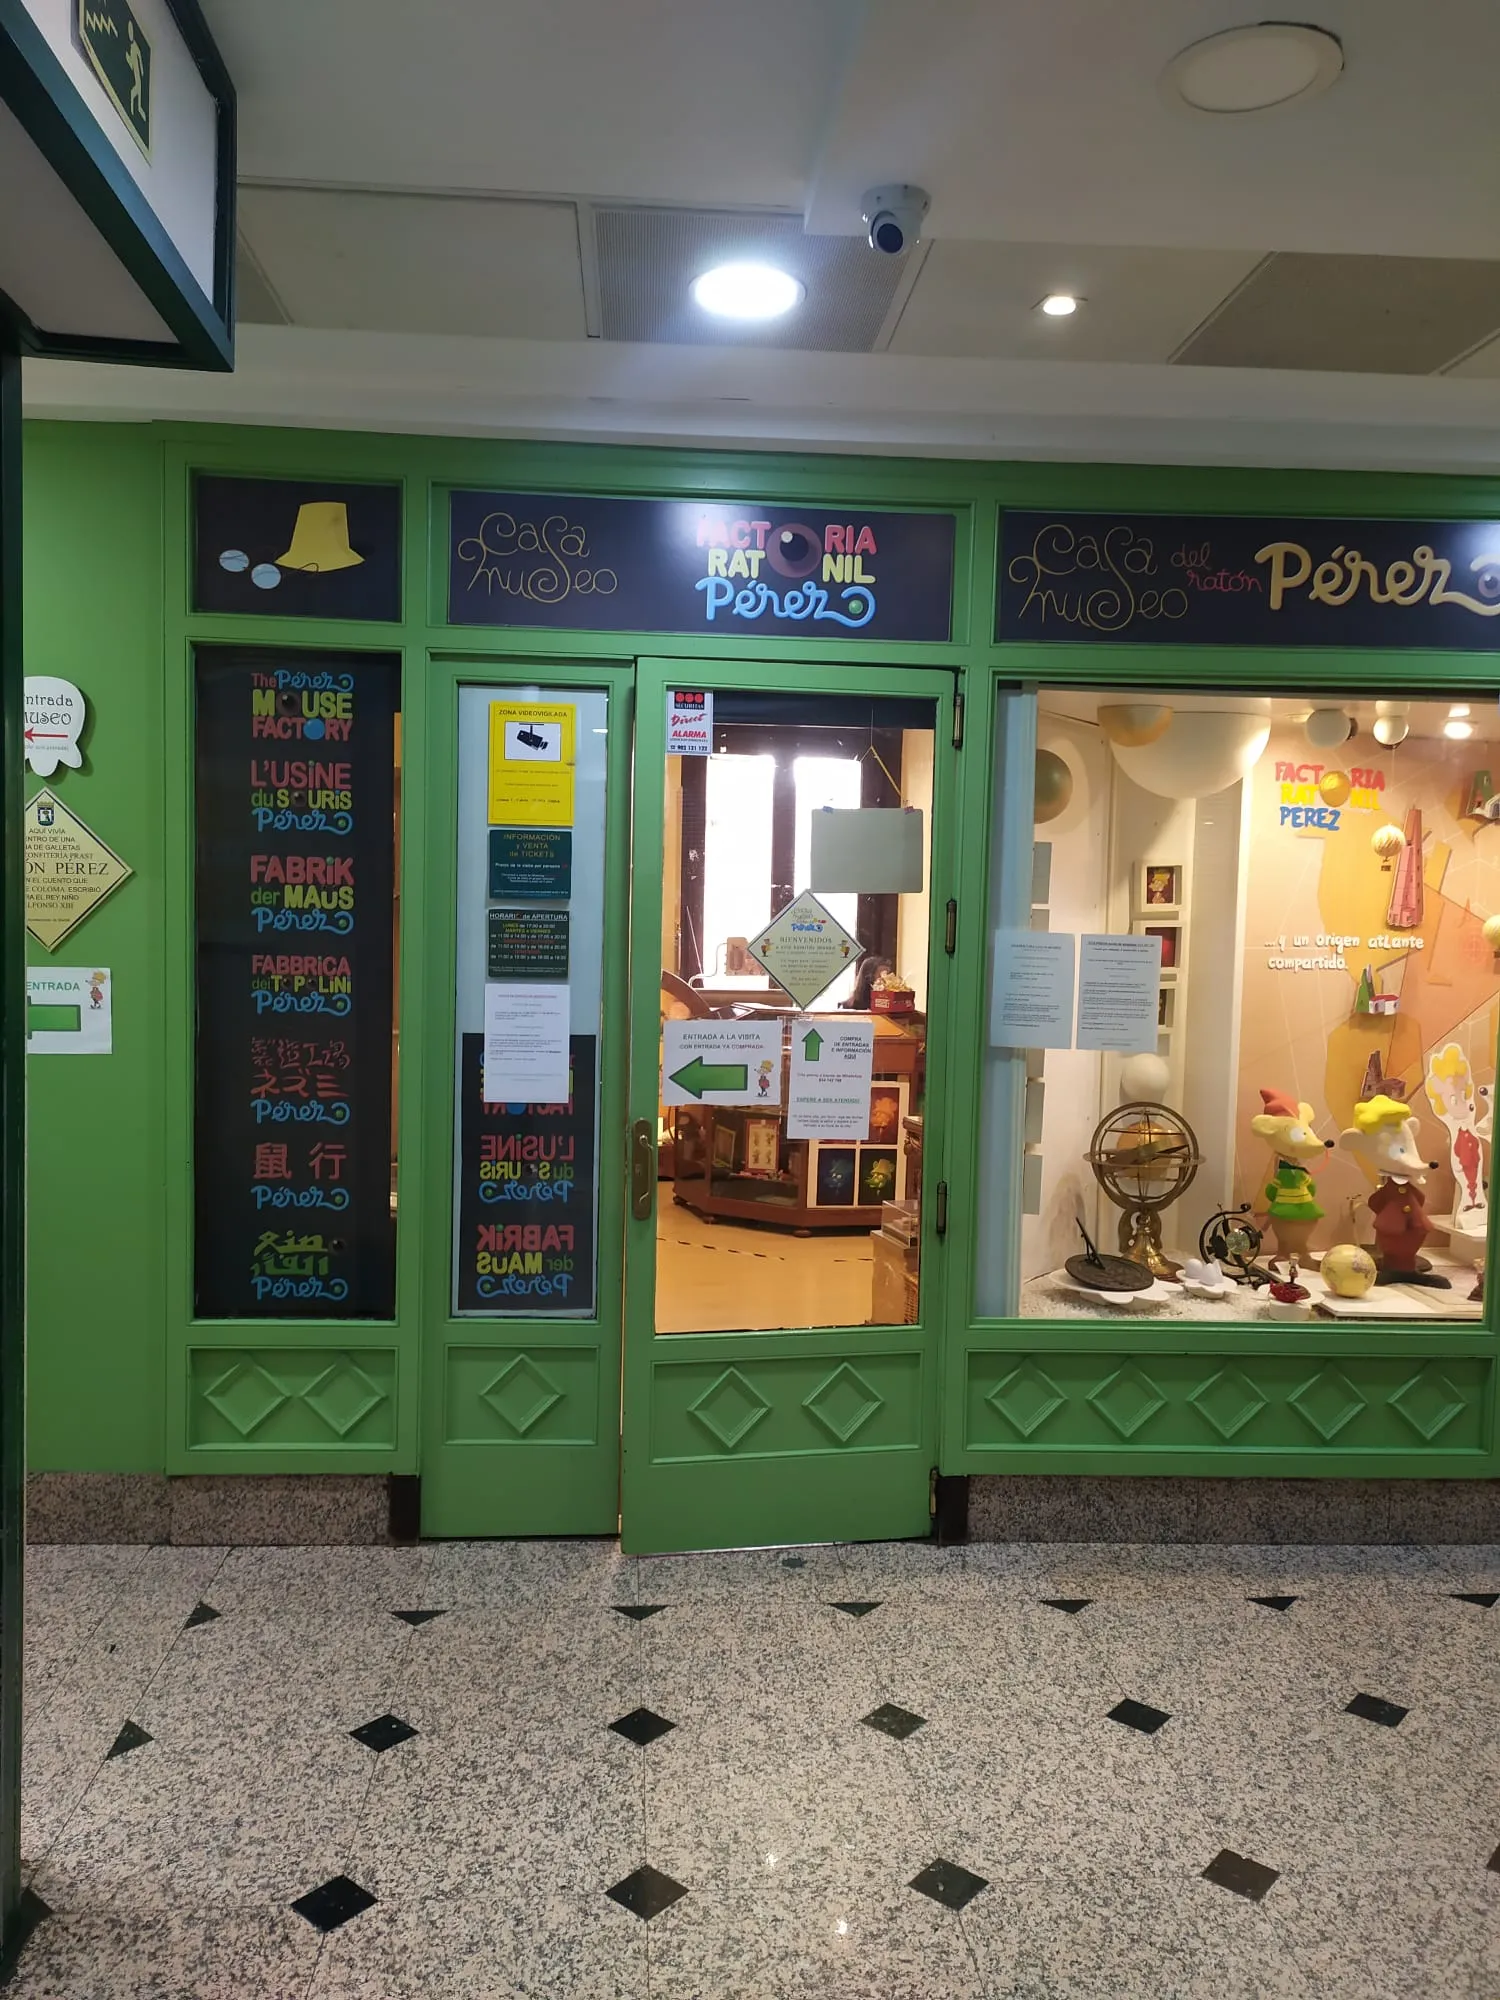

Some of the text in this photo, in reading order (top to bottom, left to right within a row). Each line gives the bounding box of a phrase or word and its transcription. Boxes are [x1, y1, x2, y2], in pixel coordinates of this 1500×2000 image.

[1170, 543, 1210, 569] del
[1186, 567, 1262, 593] ratón
[1254, 541, 1500, 617] Pérez
[695, 577, 876, 628] Pérez
[251, 669, 354, 693] The Pérez
[24, 694, 73, 706] ntrada
[518, 710, 567, 718] VIDEOVIGILADA
[671, 713, 708, 726] Direct
[672, 730, 707, 738] ALARMA
[251, 788, 273, 807] du
[251, 807, 353, 835] Pérez
[503, 833, 561, 841] INFORMACIÓN
[26, 851, 67, 859] ONFITERÍA
[56, 858, 109, 875] PÉREZ
[251, 887, 280, 906] der
[251, 907, 354, 935] Pérez
[1293, 935, 1309, 947] un
[1316, 933, 1360, 953] origen
[1268, 955, 1347, 972] compartido.
[26, 981, 80, 991] ENTRADA
[252, 977, 271, 990] dei
[251, 990, 352, 1017] Pérez
[251, 1069, 350, 1099] ネズミ
[251, 1098, 350, 1125] Pérez
[251, 1185, 349, 1211] Pérez
[251, 1276, 348, 1300] Pérez
